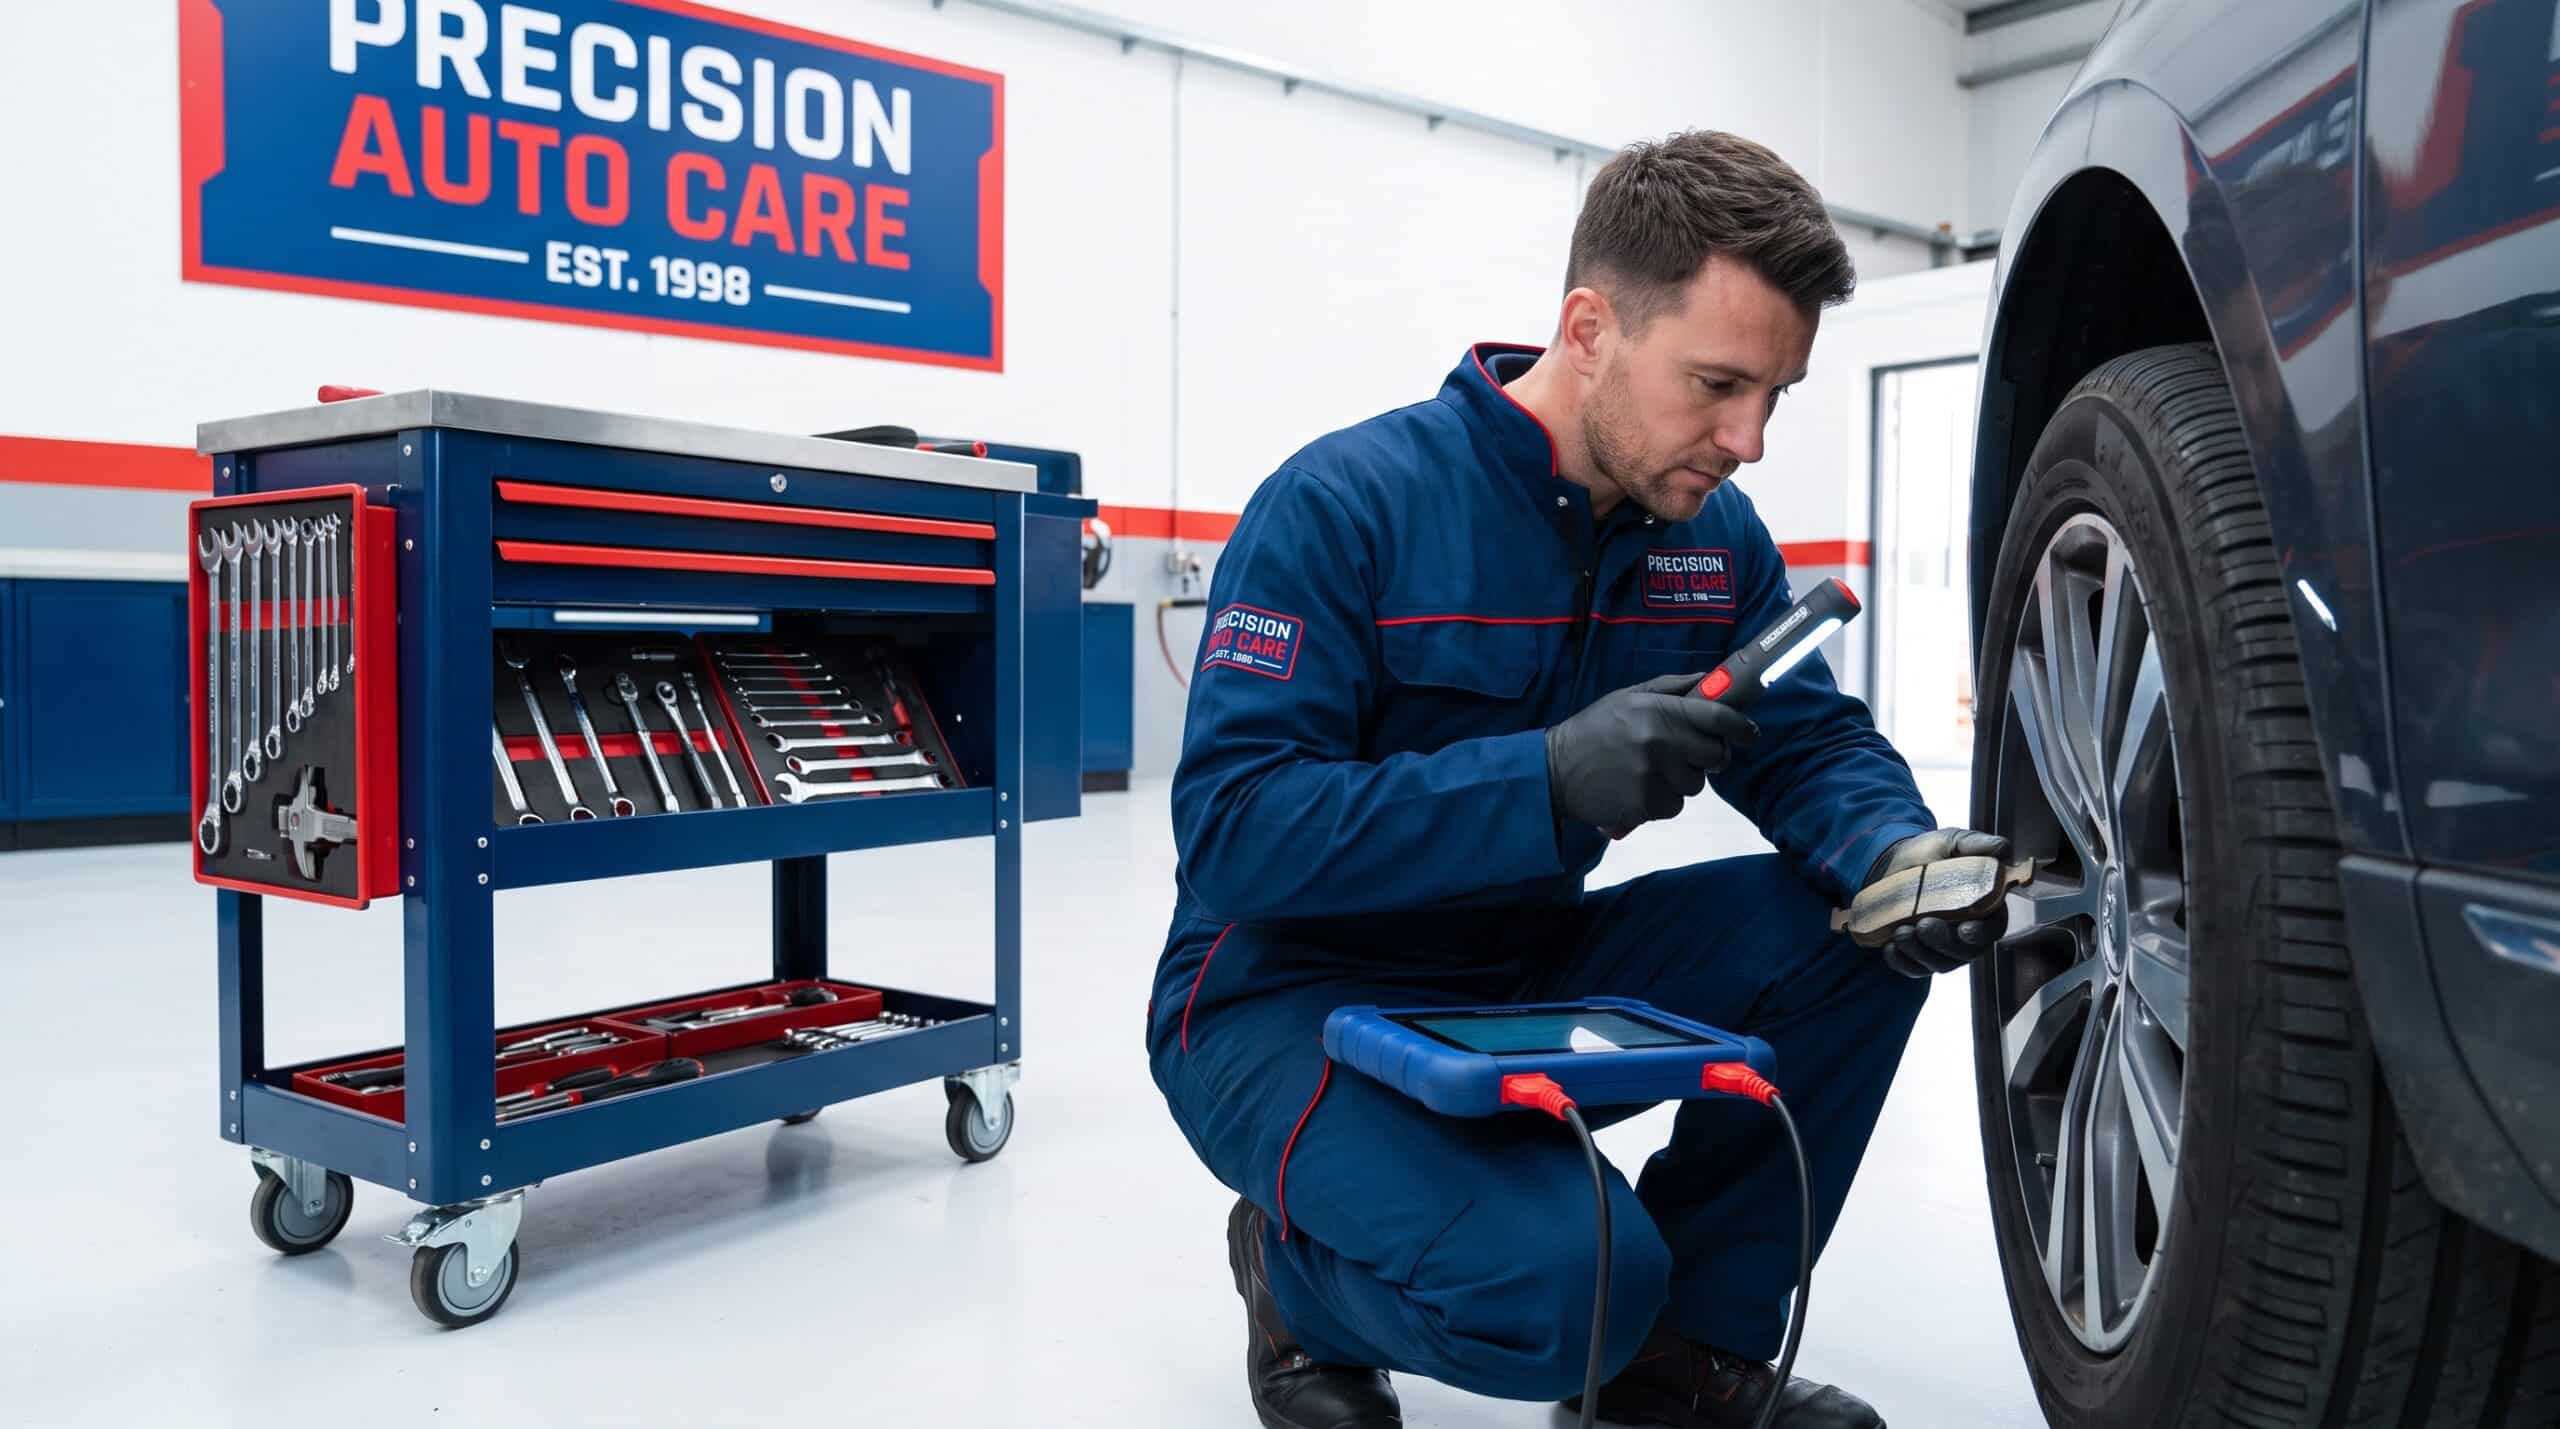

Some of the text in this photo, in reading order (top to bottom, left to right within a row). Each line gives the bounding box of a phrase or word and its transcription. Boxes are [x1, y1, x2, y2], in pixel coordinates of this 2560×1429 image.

[330, 0, 912, 175] PRECISION
[330, 94, 910, 270] AUTO CARE
[546, 241, 751, 306] EST. 1998
[1647, 554, 1724, 573] PRECISION
[1649, 573, 1729, 591] AUTO CARE
[1237, 632, 1289, 662] CARE
